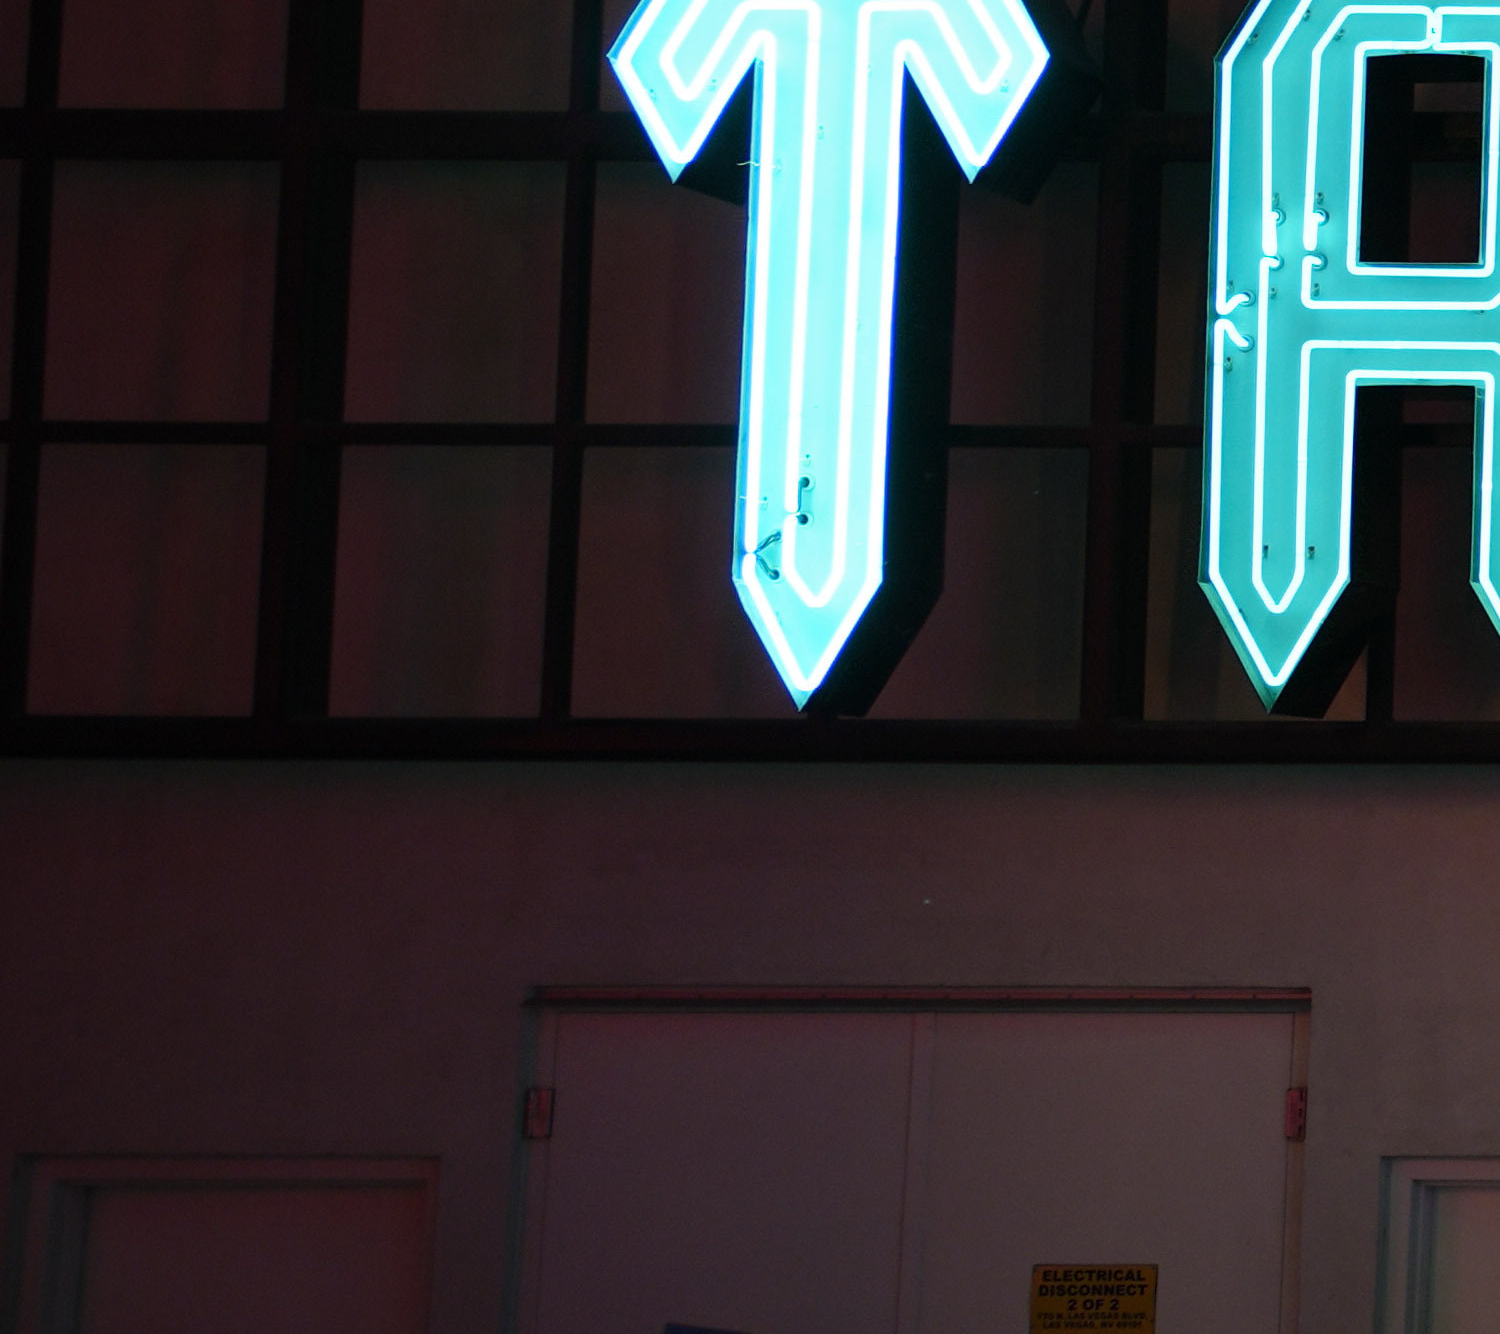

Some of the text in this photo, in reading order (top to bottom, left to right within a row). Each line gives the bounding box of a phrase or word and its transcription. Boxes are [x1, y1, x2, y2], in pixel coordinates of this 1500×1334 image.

[1042, 1270, 1147, 1282] ELECTRICAL
[1038, 1284, 1149, 1296] DISCONNECT
[1067, 1299, 1120, 1311] 2 OF 2
[1088, 1312, 1119, 1320] VEGAS
